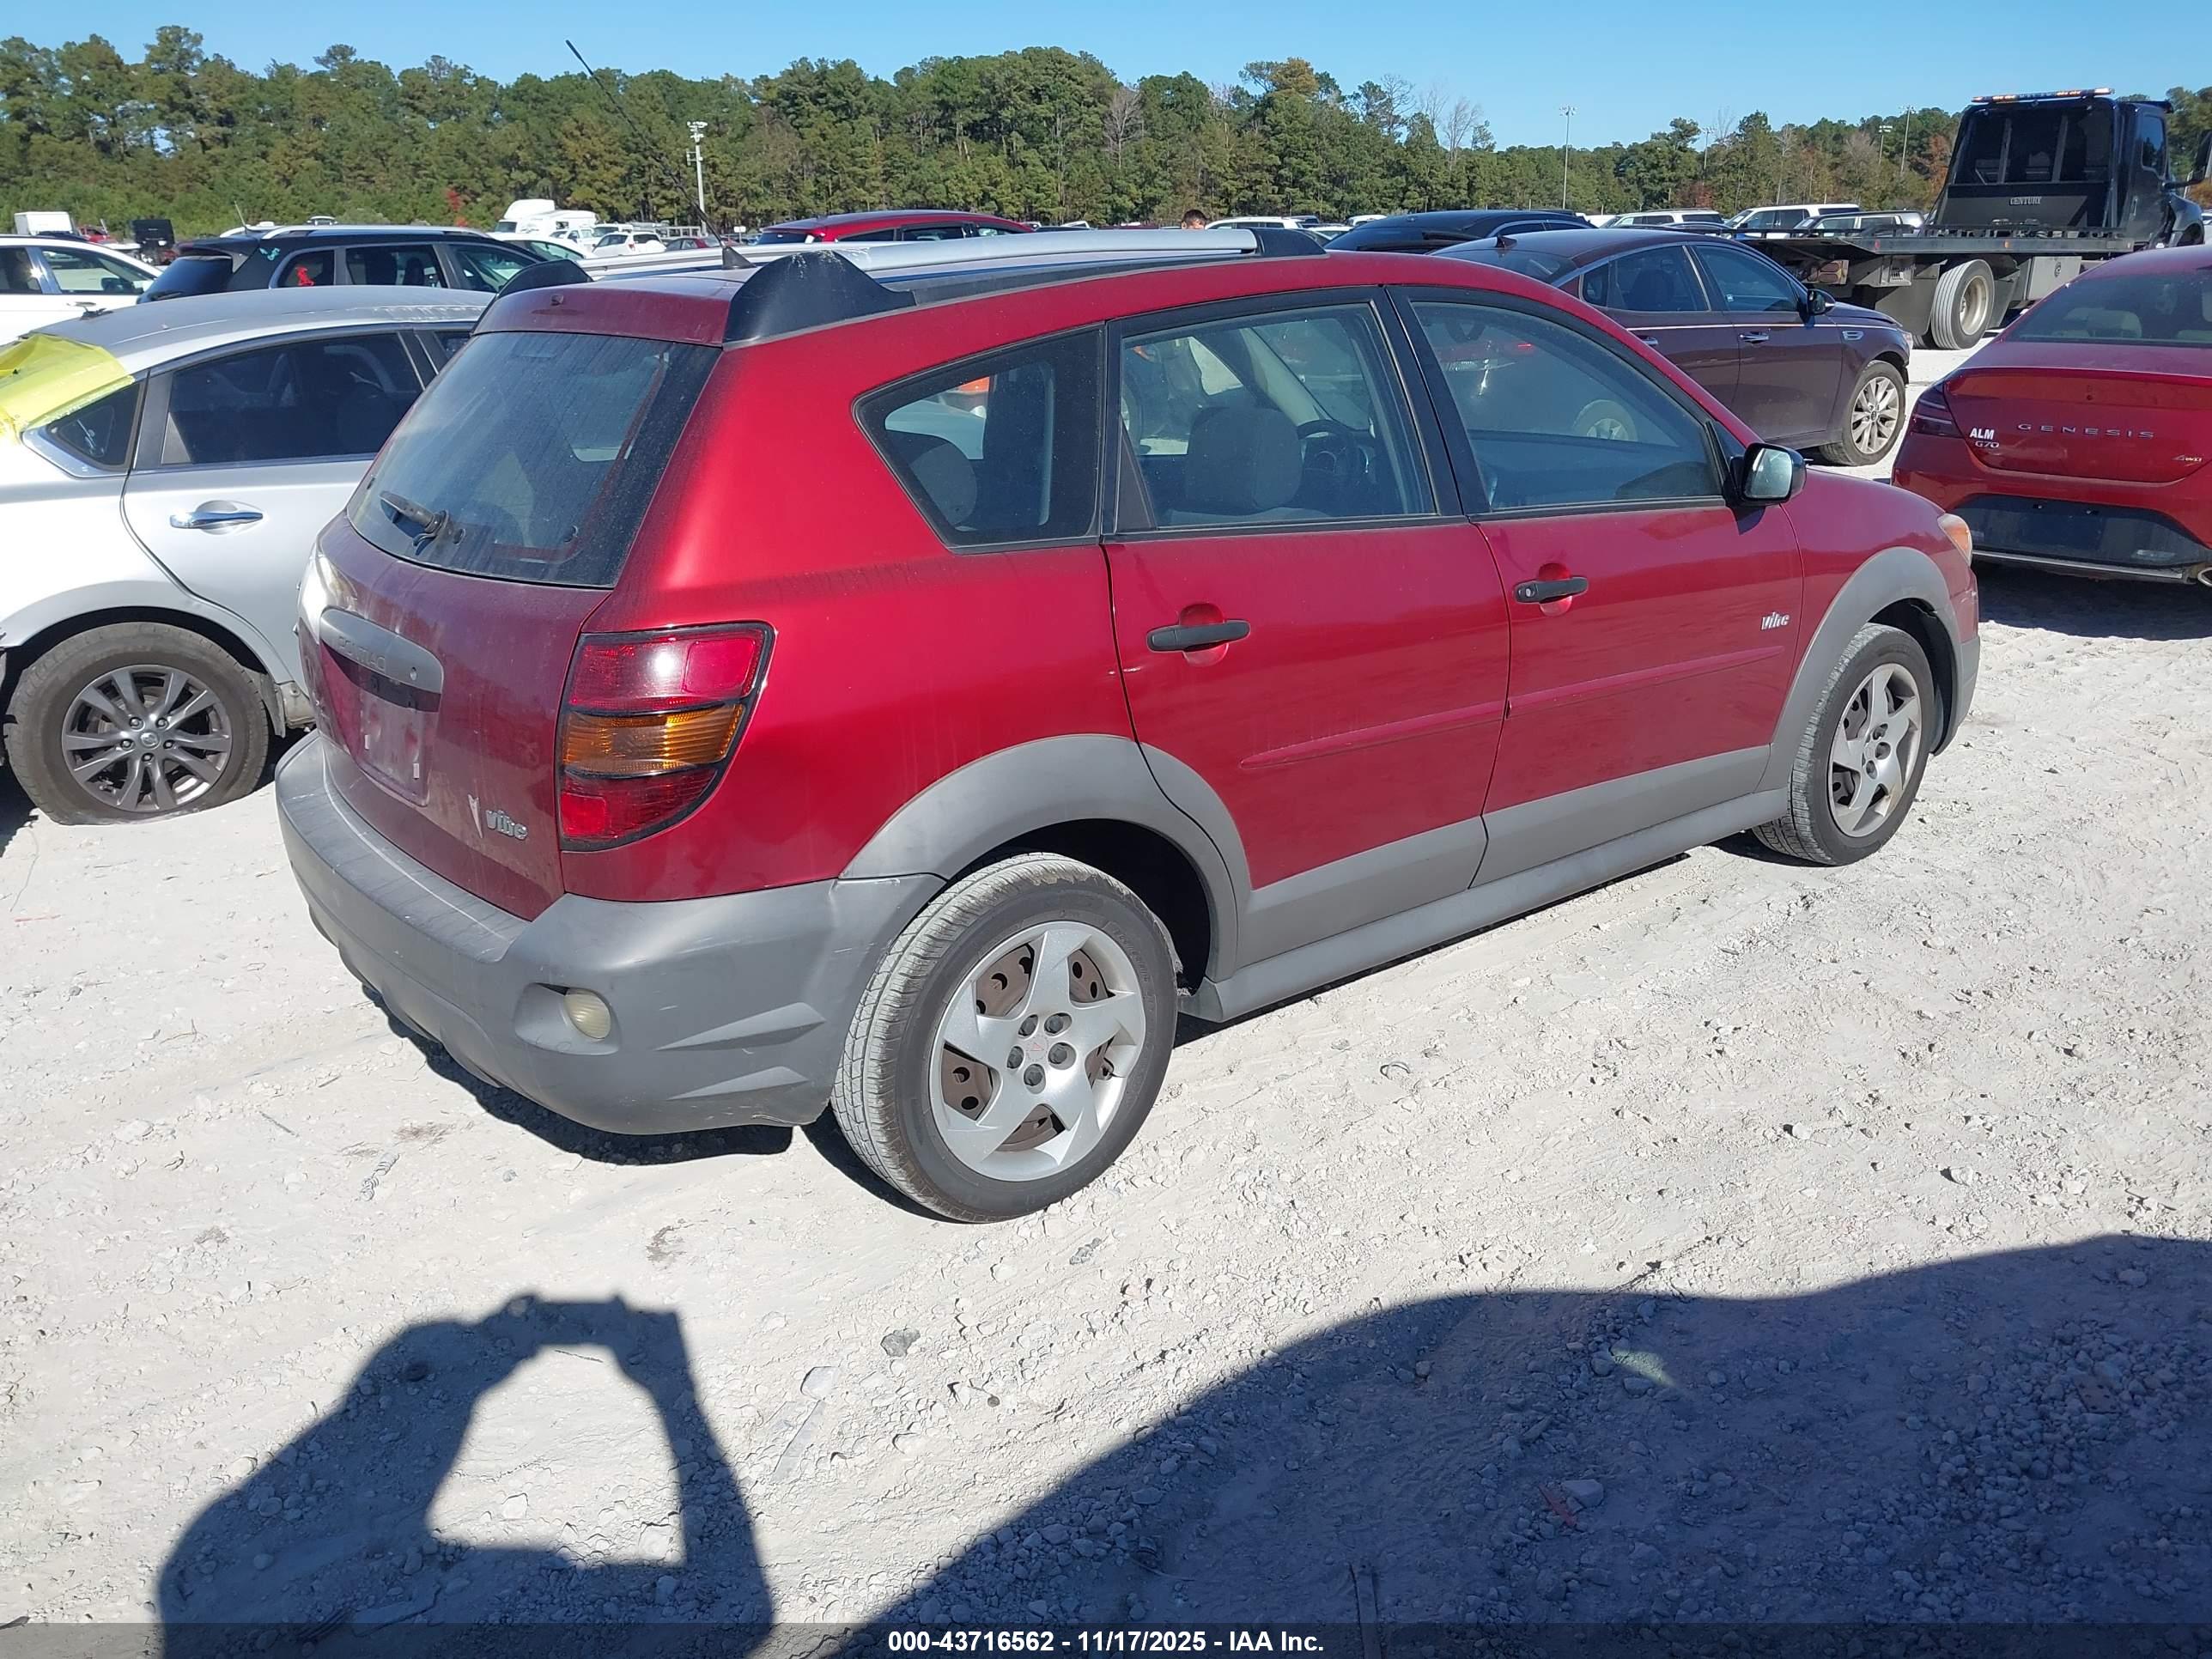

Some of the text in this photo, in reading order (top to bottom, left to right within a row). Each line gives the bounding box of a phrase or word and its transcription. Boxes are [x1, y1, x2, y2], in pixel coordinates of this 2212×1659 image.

[2009, 196, 2042, 205] CENTURY
[1969, 428, 1995, 440] ALM
[2018, 423, 2154, 439] GENESIS
